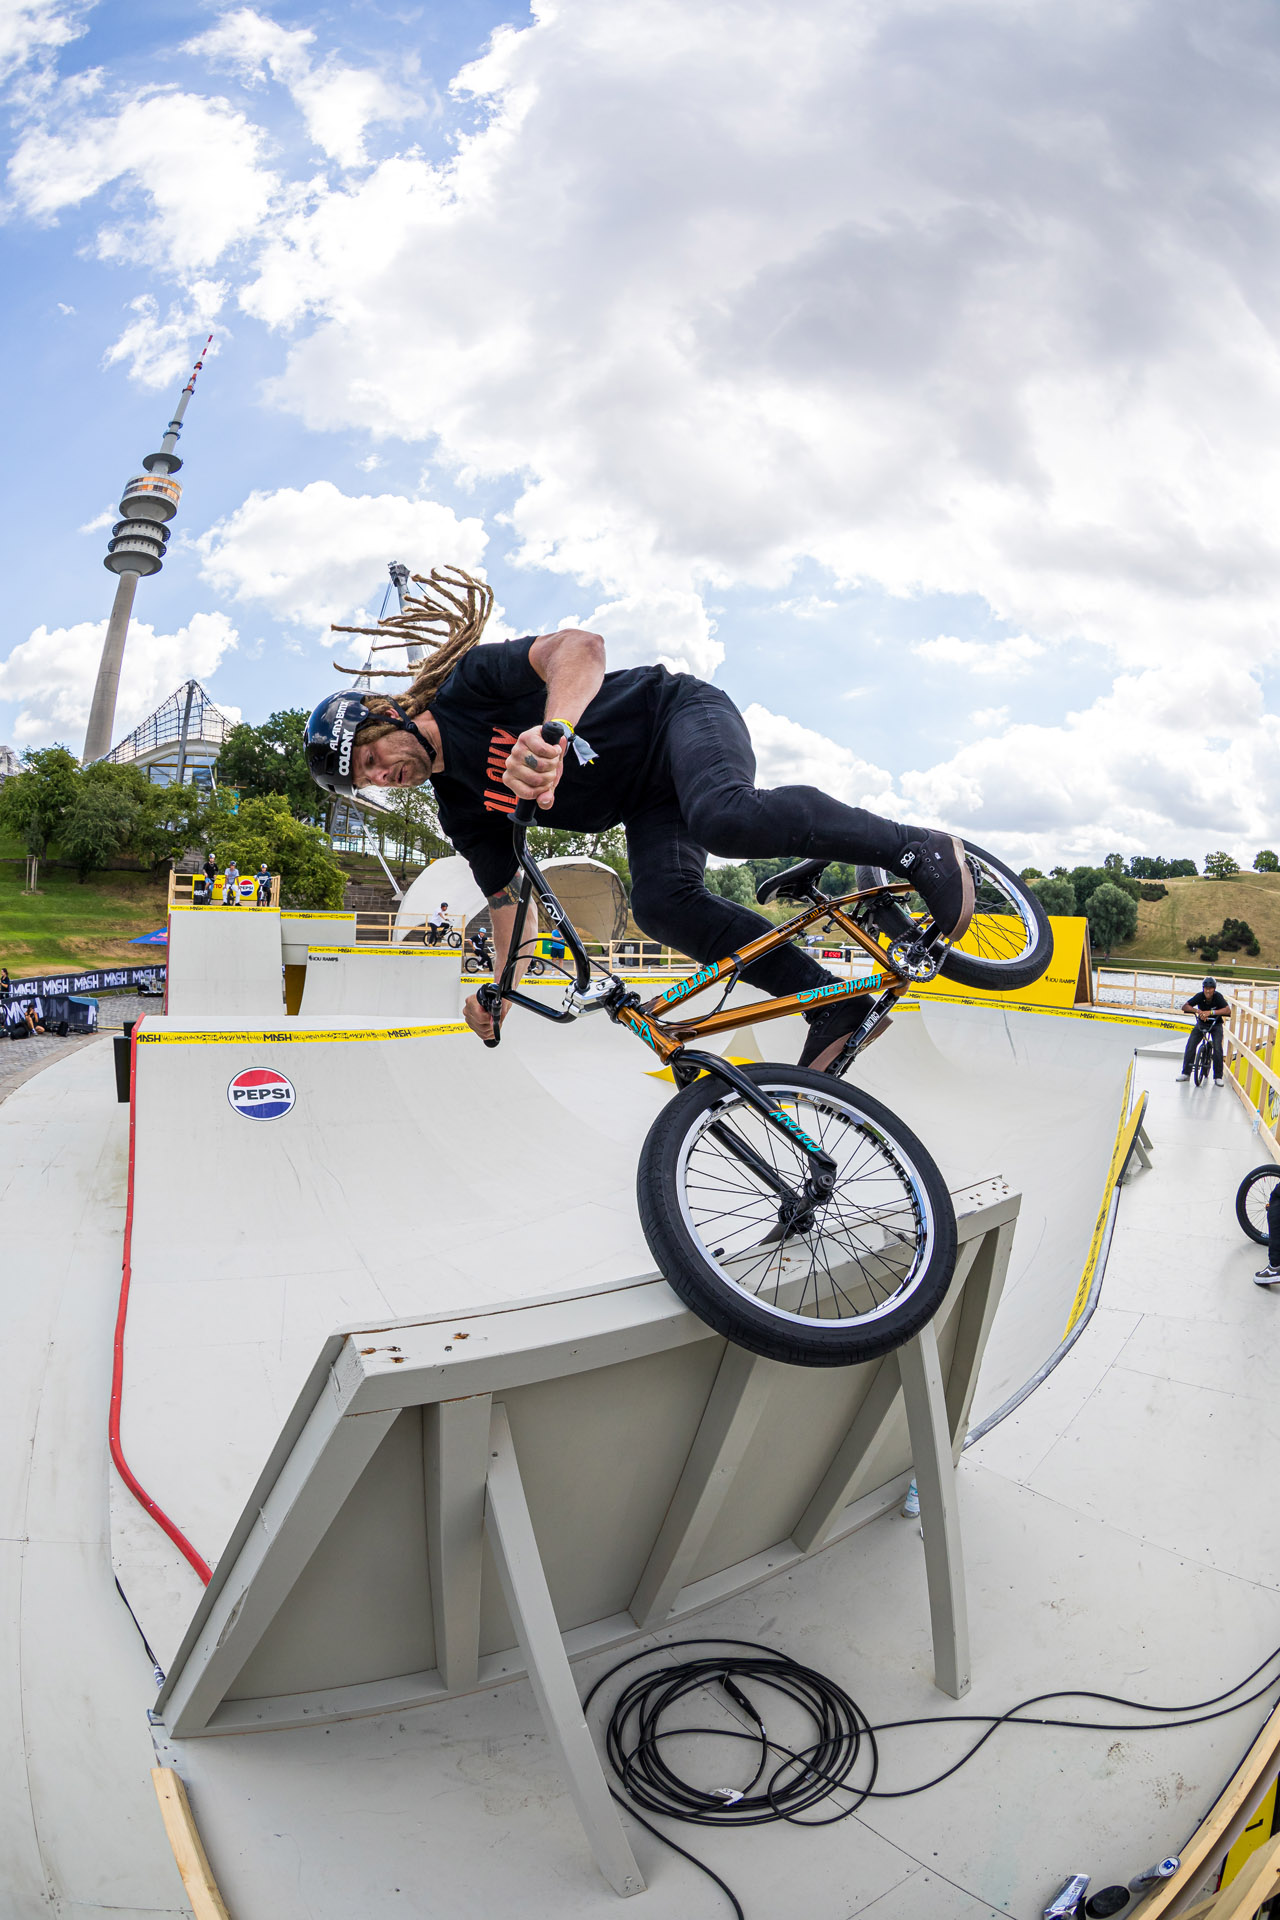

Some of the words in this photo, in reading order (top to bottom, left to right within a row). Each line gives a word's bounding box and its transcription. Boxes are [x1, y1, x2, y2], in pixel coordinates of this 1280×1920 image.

[338, 729, 354, 776] COLONY
[43, 978, 69, 995] MASH
[74, 974, 99, 991] MASH
[104, 971, 128, 986] MASH
[861, 1010, 880, 1033] COLONY
[1159, 1021, 1175, 1029] MASH
[263, 1033, 293, 1042] MASH
[387, 1029, 413, 1039] MASH
[233, 1088, 291, 1101] PEPSI
